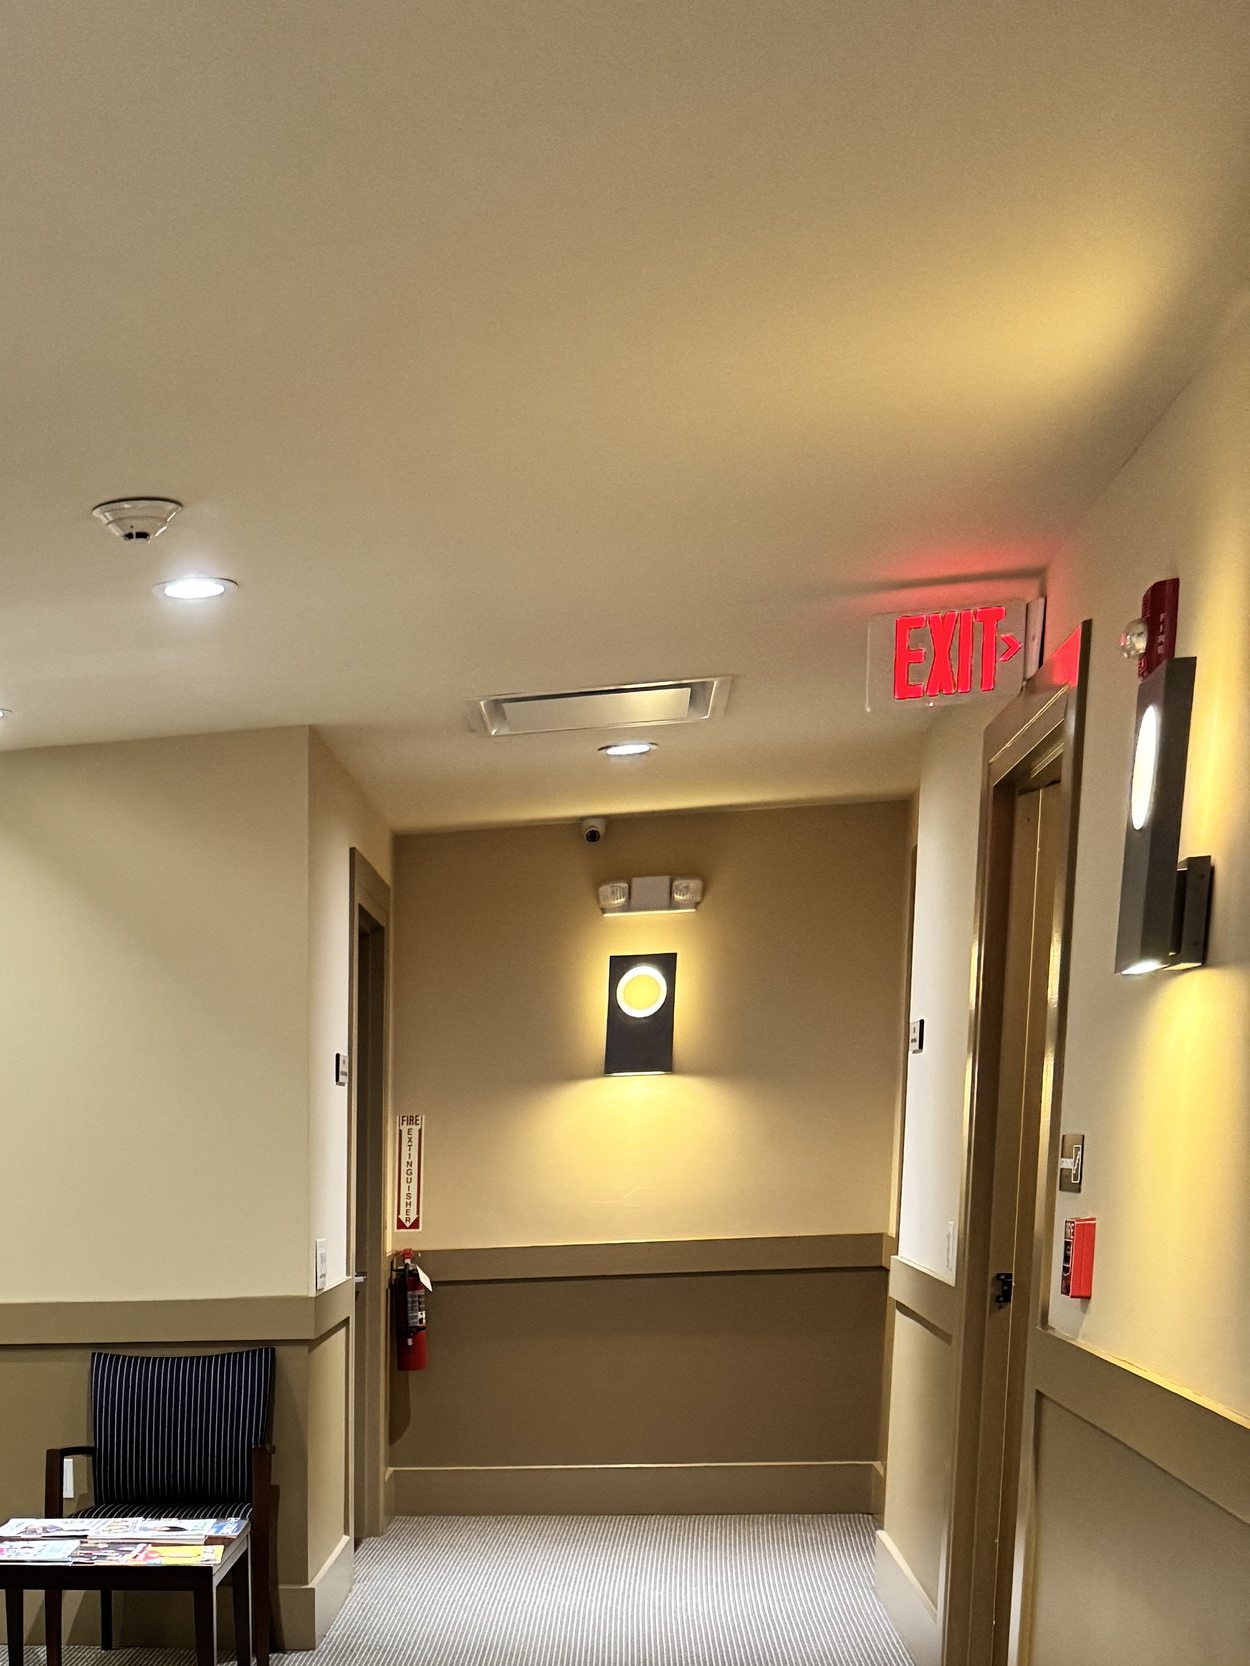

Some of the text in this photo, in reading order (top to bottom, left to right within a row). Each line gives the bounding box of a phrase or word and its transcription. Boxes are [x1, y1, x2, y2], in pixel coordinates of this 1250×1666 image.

[894, 606, 1006, 700] EXIT
[1157, 612, 1167, 655] FIRE
[401, 1115, 420, 1126] FIRE
[405, 1128, 413, 1224] EXTINGUISHER
